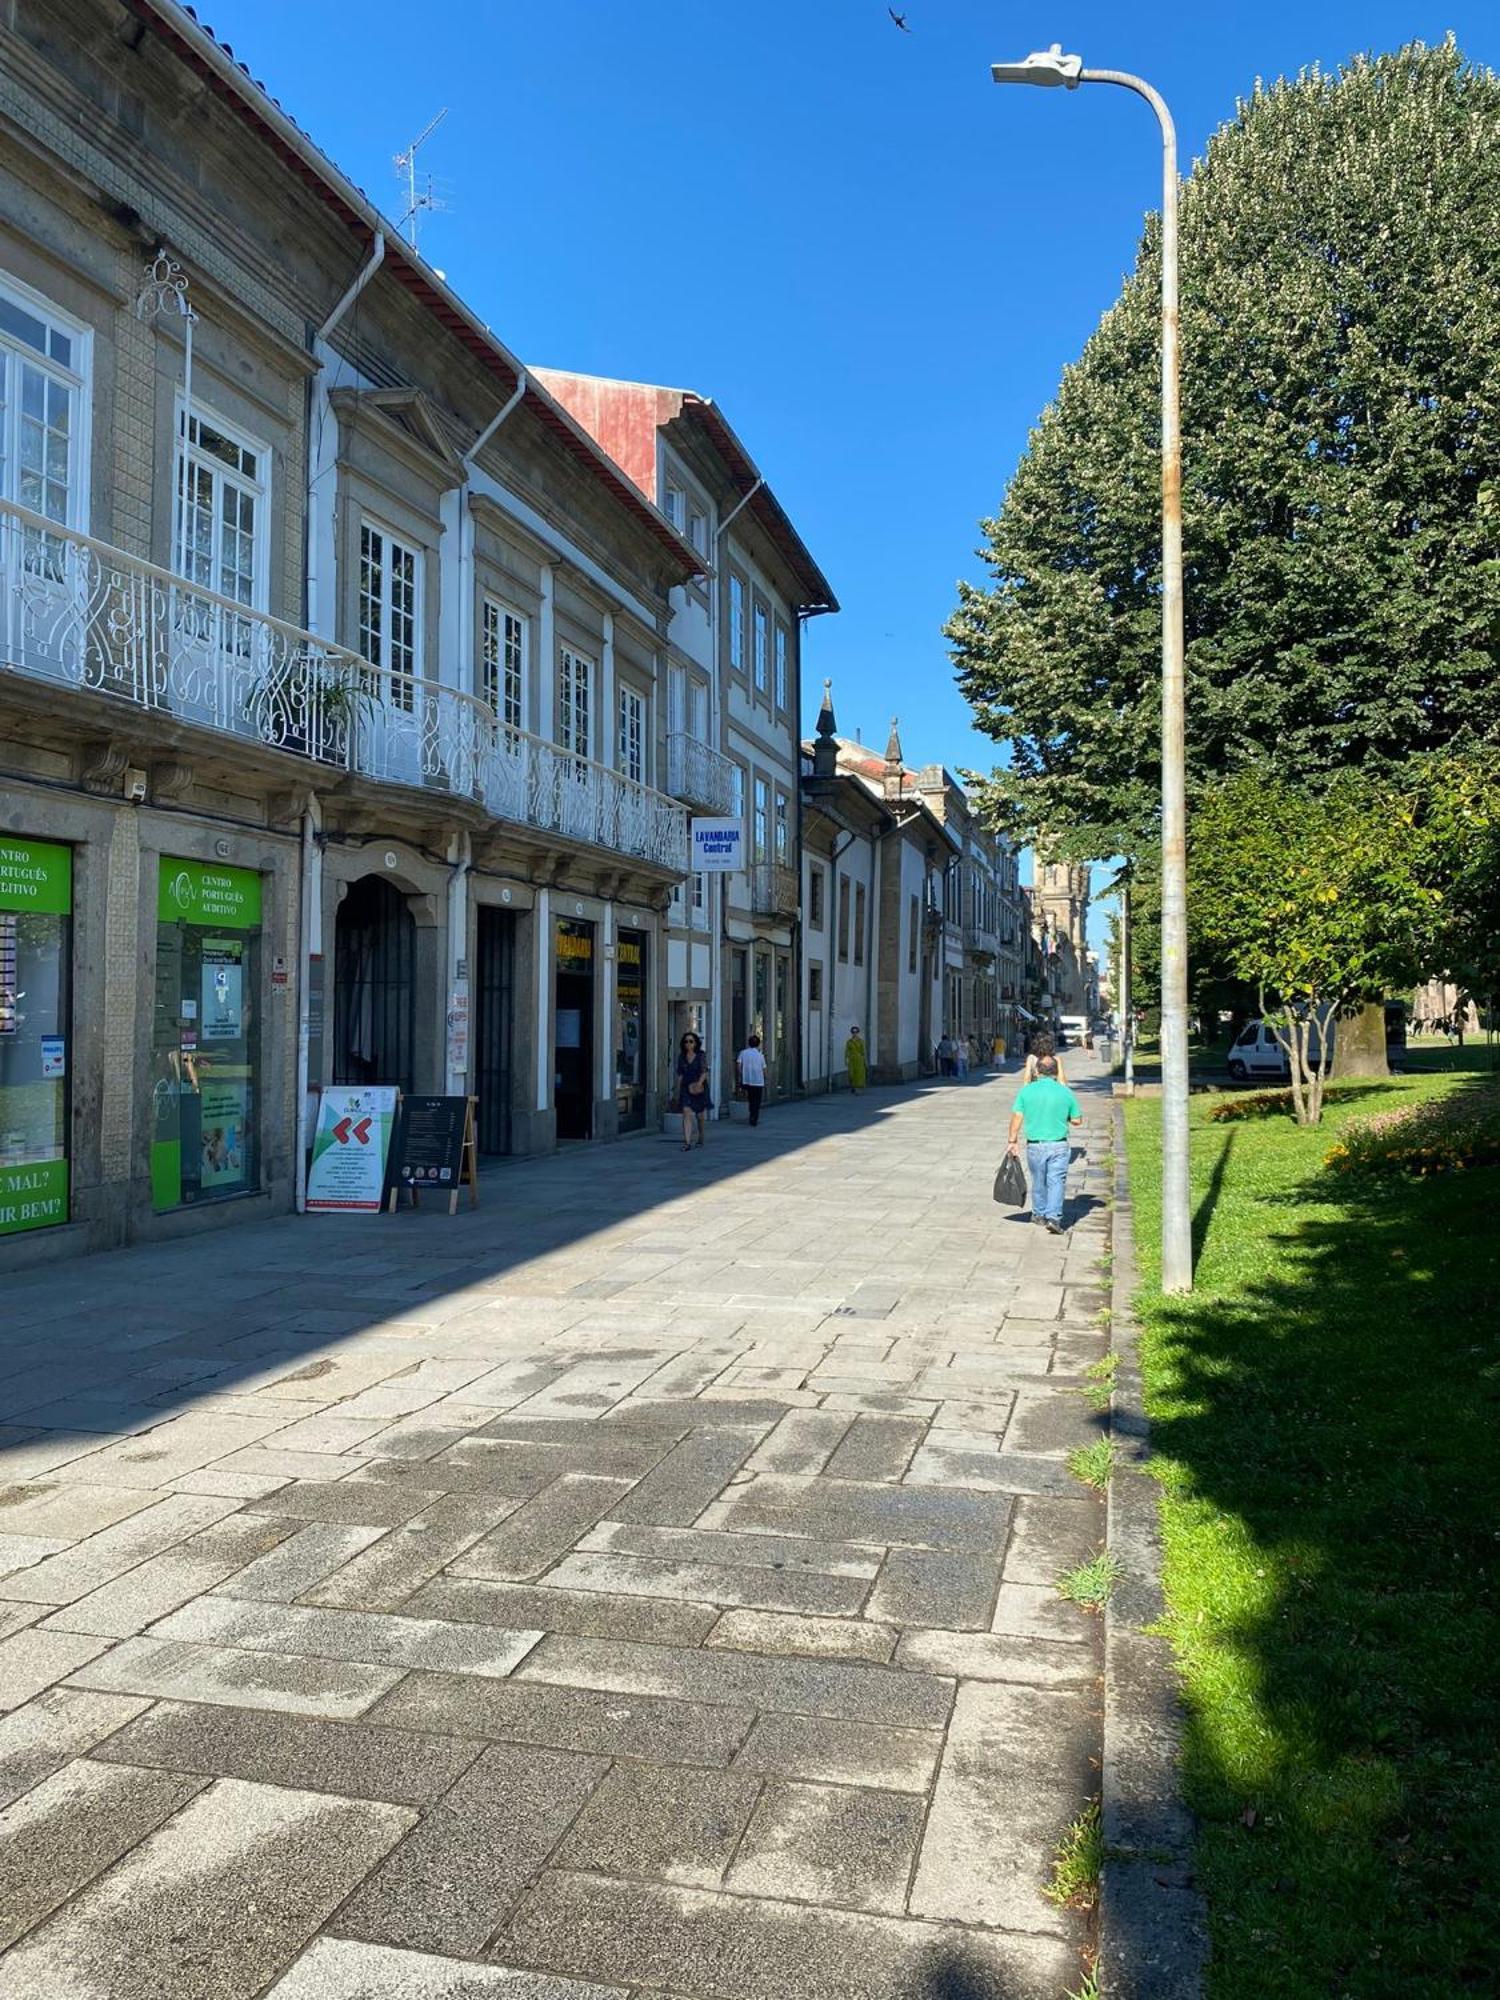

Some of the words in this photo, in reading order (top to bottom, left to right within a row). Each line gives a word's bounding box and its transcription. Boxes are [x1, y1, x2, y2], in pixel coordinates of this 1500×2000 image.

[695, 831, 740, 842] LAVANDARIA
[703, 843, 732, 853] Central
[202, 876, 232, 888] CENTRO
[202, 889, 245, 904] PORTUGUÊS
[203, 903, 237, 916] AUDITIVO
[7, 1171, 49, 1193] MAL?
[21, 1198, 61, 1220] BEM?
